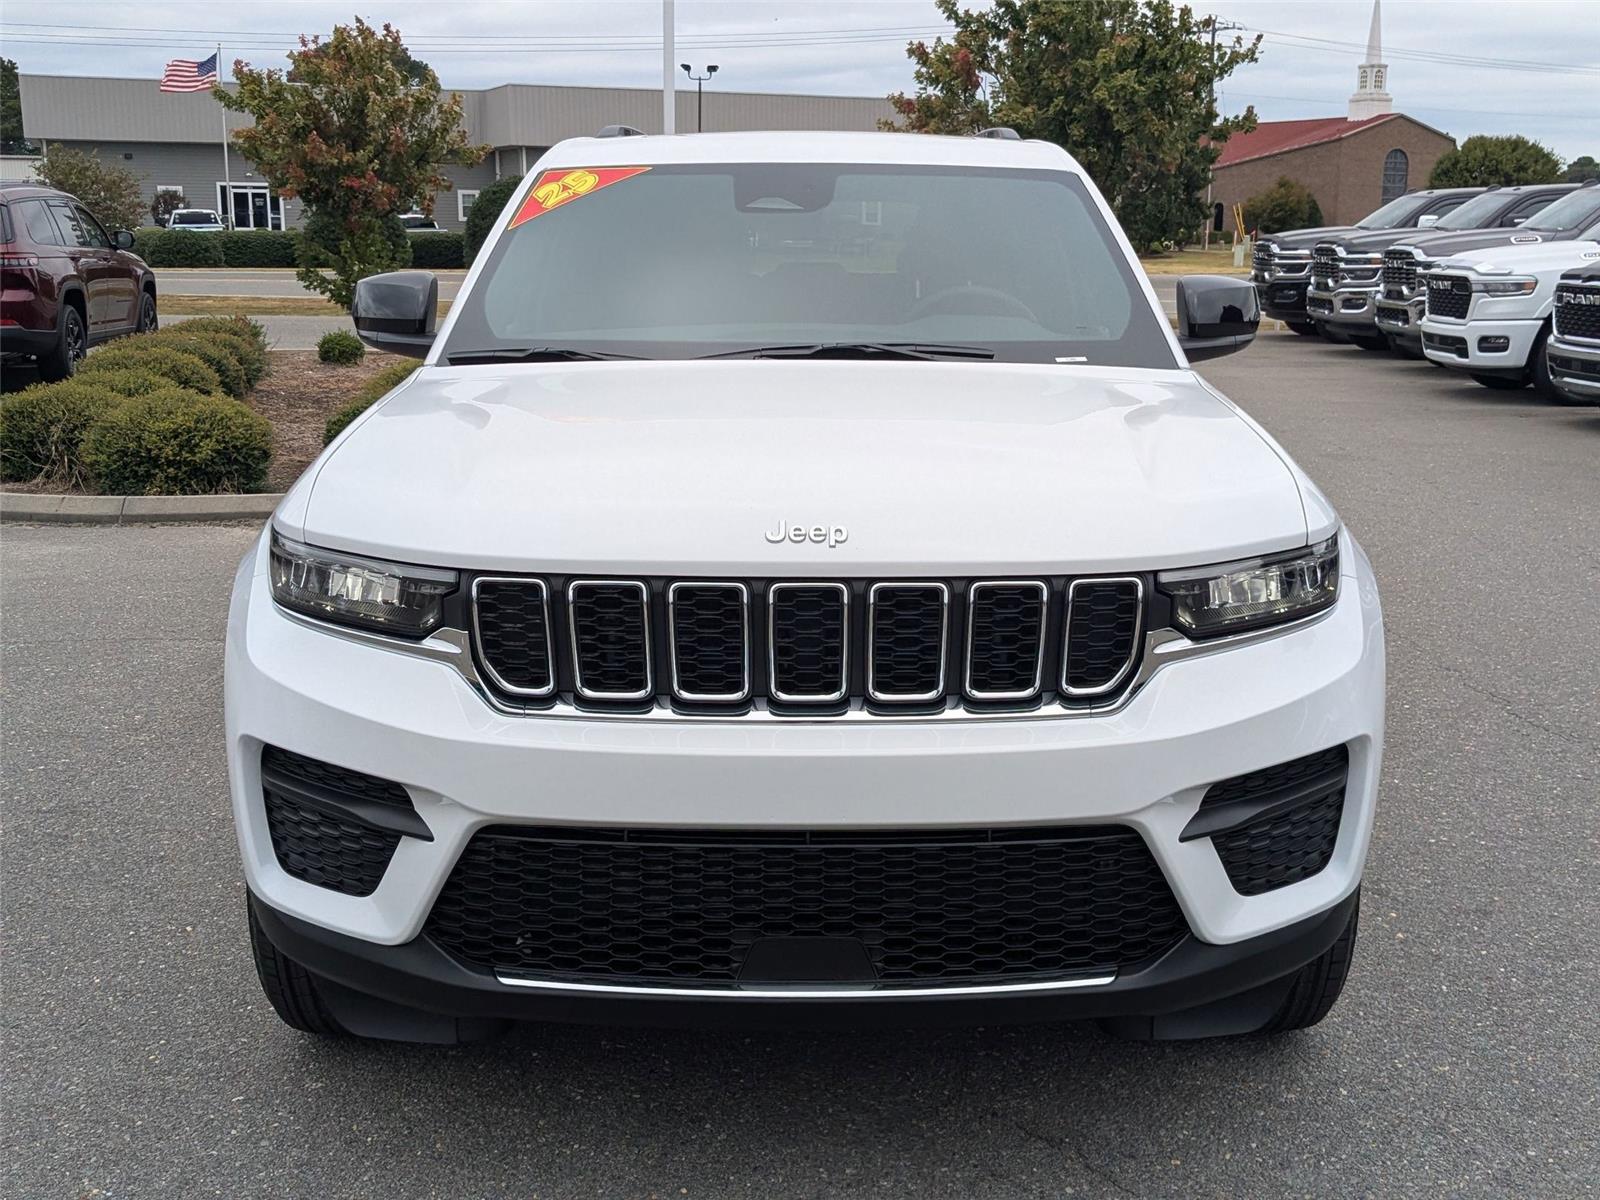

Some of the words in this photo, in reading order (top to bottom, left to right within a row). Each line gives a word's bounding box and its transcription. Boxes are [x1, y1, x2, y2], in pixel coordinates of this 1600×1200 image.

[532, 169, 600, 209] 25
[1429, 280, 1453, 290] RAM
[1563, 292, 1600, 305] RAM
[765, 519, 849, 548] Jeep
